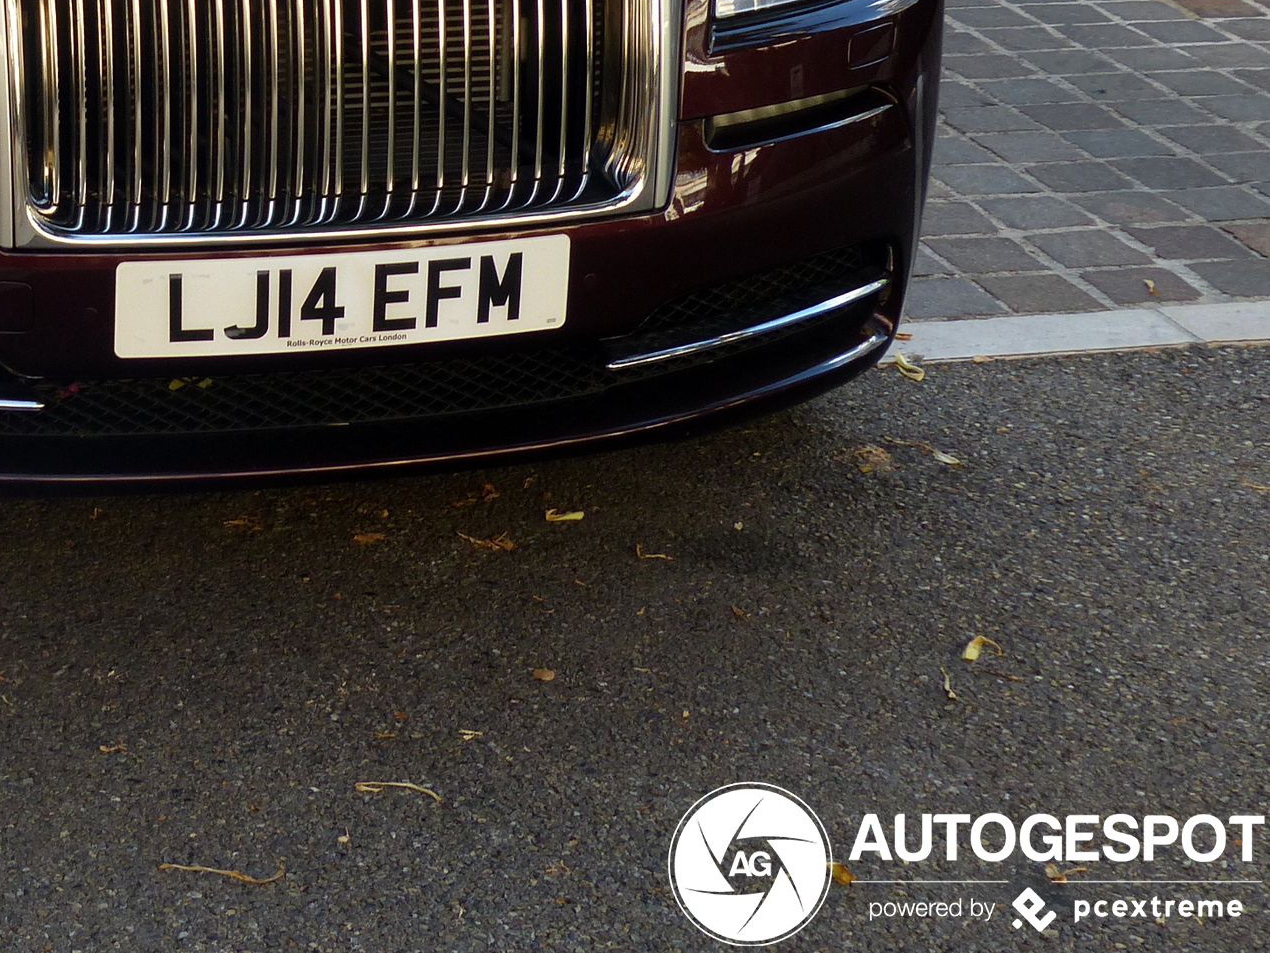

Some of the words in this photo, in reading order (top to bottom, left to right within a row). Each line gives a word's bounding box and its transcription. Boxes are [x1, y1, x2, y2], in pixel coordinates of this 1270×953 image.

[168, 266, 346, 343] LJ14
[372, 251, 523, 333] EFM
[287, 338, 333, 348] Rolls-Royce
[334, 337, 358, 346] Motor
[359, 335, 377, 343] Cars
[379, 333, 407, 342] London
